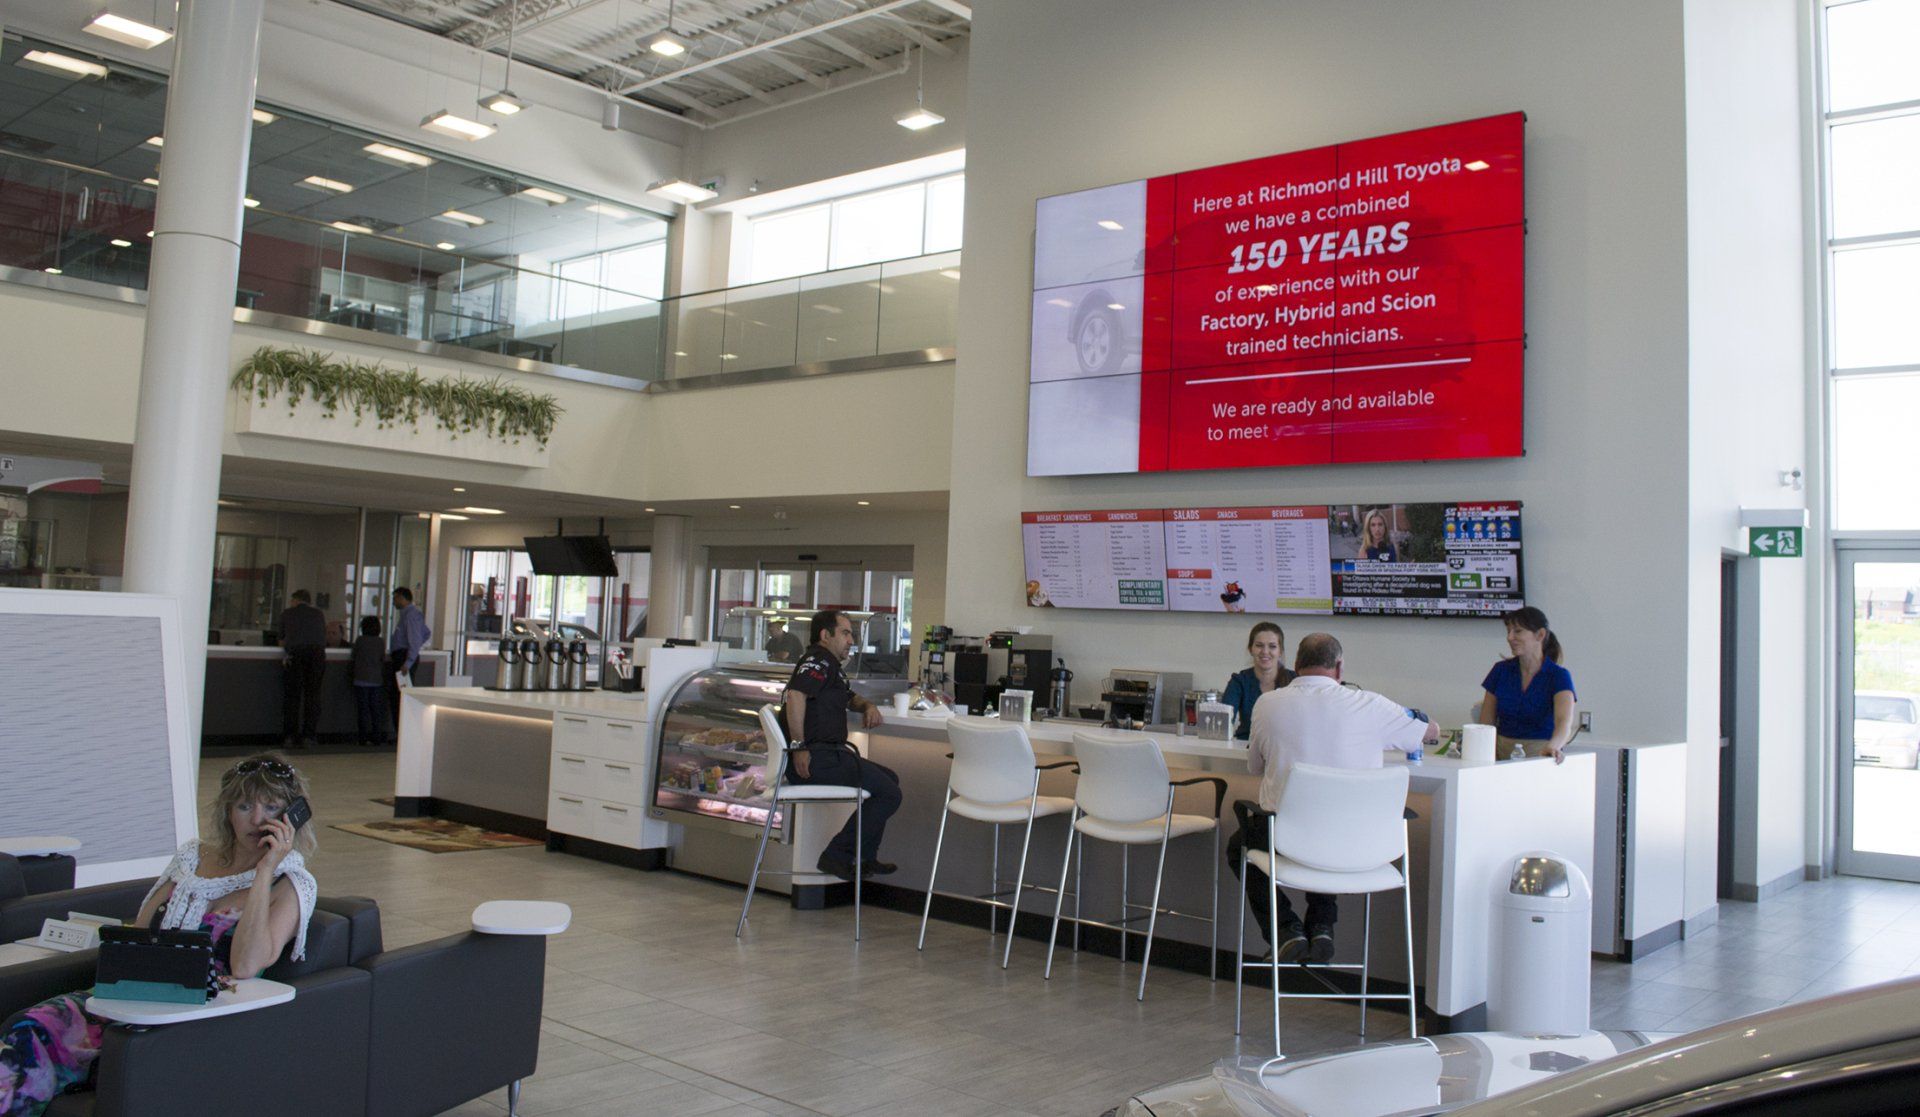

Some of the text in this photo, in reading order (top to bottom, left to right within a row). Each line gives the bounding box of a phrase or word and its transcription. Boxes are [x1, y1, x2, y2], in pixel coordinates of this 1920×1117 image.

[1193, 157, 1462, 214] Here at Richmond Hill Toyota
[1225, 190, 1410, 234] we have a combined
[1227, 221, 1411, 274] 150 YEARS
[1215, 265, 1420, 303] of experience with our
[1200, 292, 1437, 332] Factory, Hybrid and Scion
[1225, 324, 1404, 356] trained technicians.
[1212, 388, 1436, 419] We are ready and available
[1207, 426, 1224, 441] to
[1228, 423, 1269, 440] meet
[1173, 510, 1200, 520] SALADS
[1217, 510, 1238, 519] SNACKS
[1272, 509, 1304, 518] BEVERAGES
